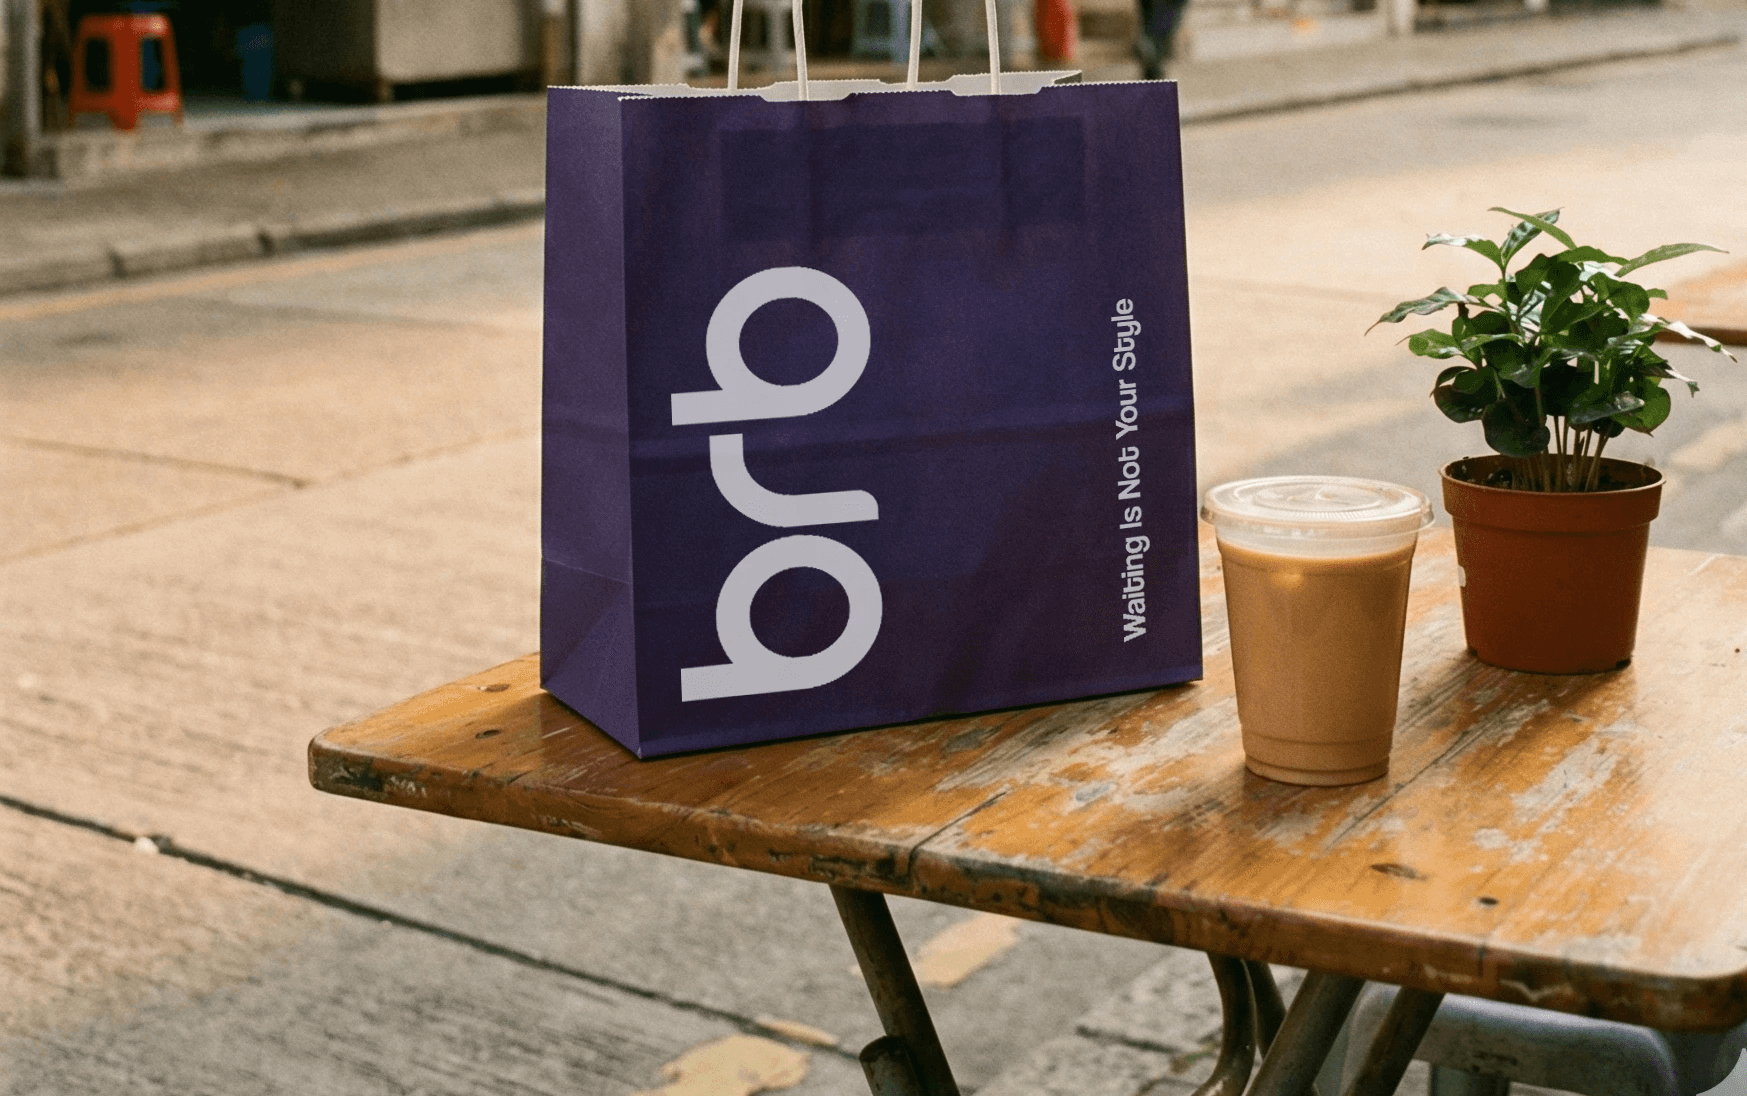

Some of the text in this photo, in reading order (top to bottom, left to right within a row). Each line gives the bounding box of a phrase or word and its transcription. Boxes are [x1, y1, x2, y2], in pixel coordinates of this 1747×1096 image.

[671, 266, 883, 702] brb
[1110, 298, 1151, 643] Waiting Is Not Your Style
